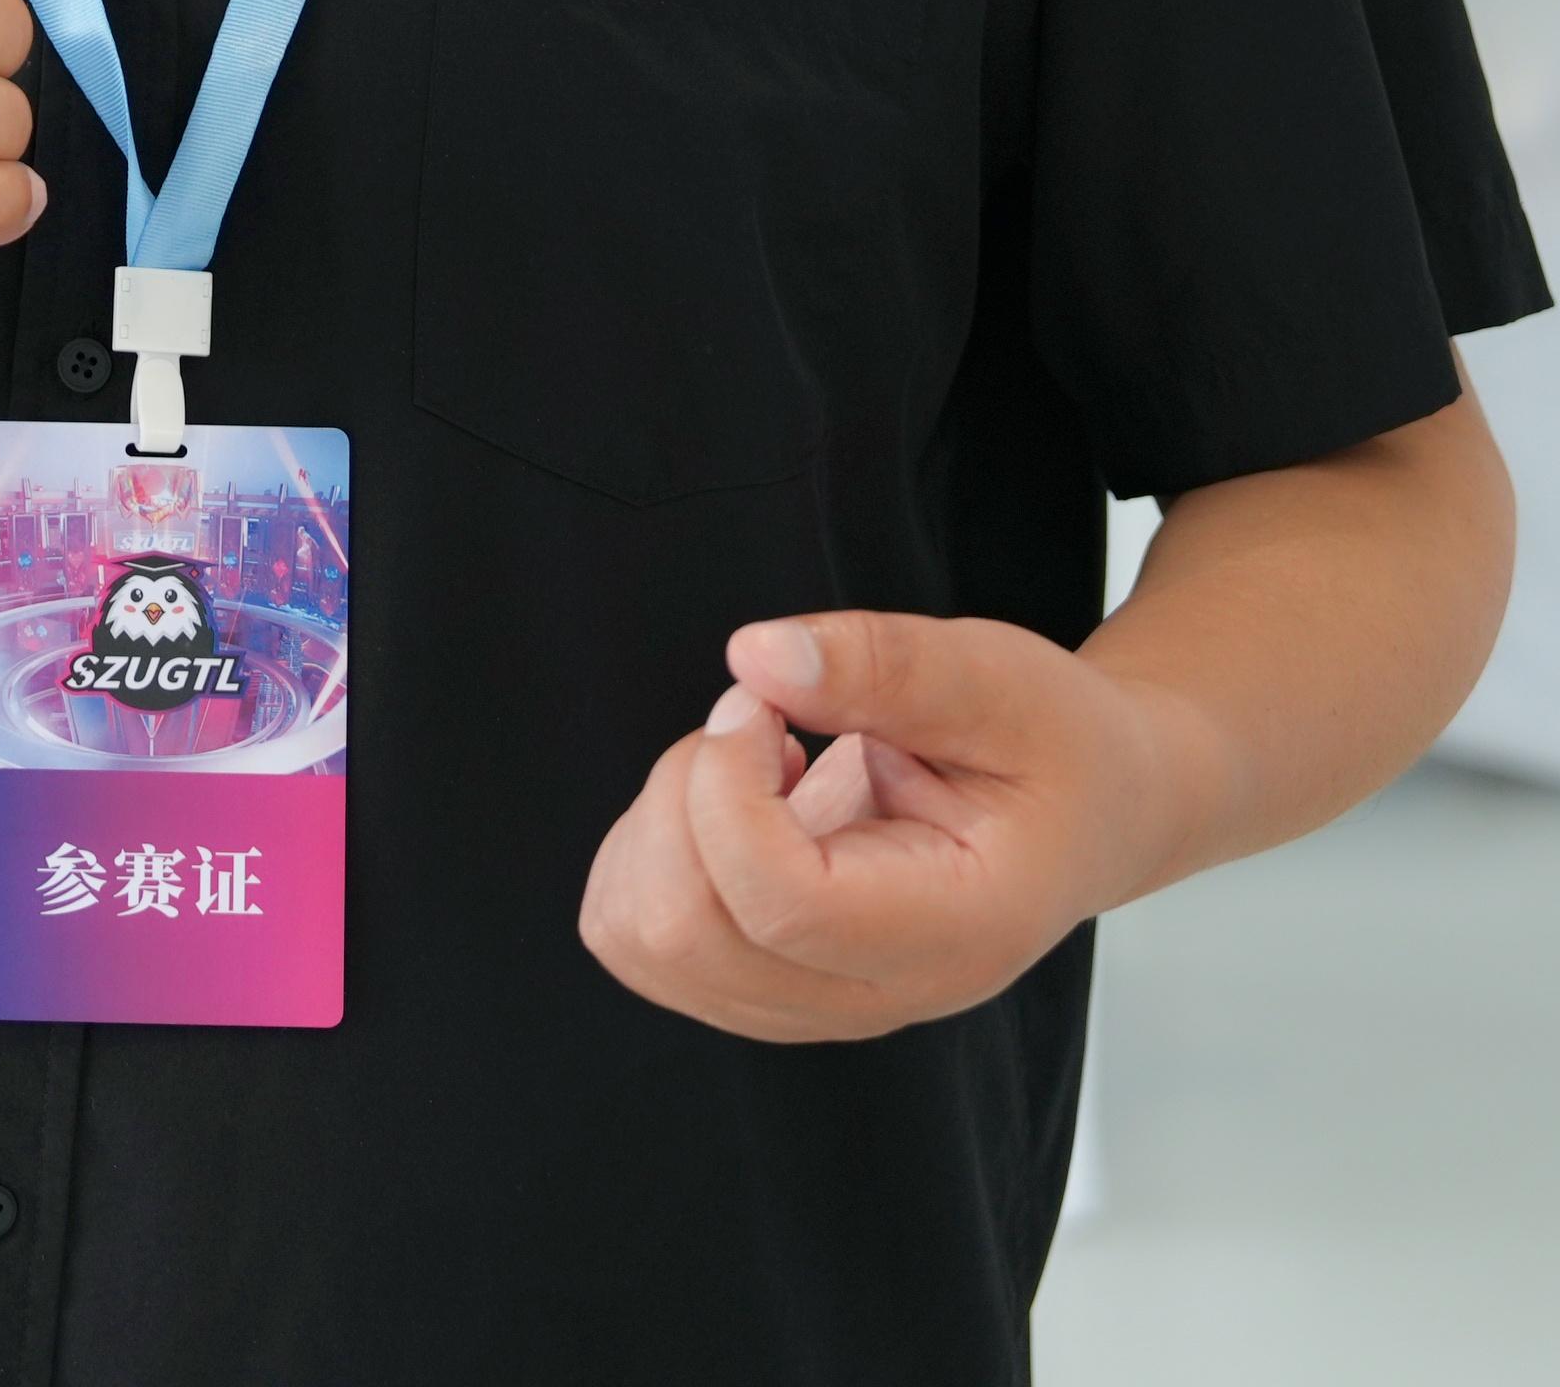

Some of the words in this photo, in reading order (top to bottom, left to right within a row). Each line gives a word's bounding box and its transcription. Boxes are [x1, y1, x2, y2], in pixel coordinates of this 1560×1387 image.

[66, 655, 240, 691] SZUGTL
[35, 842, 264, 919] 参赛证
